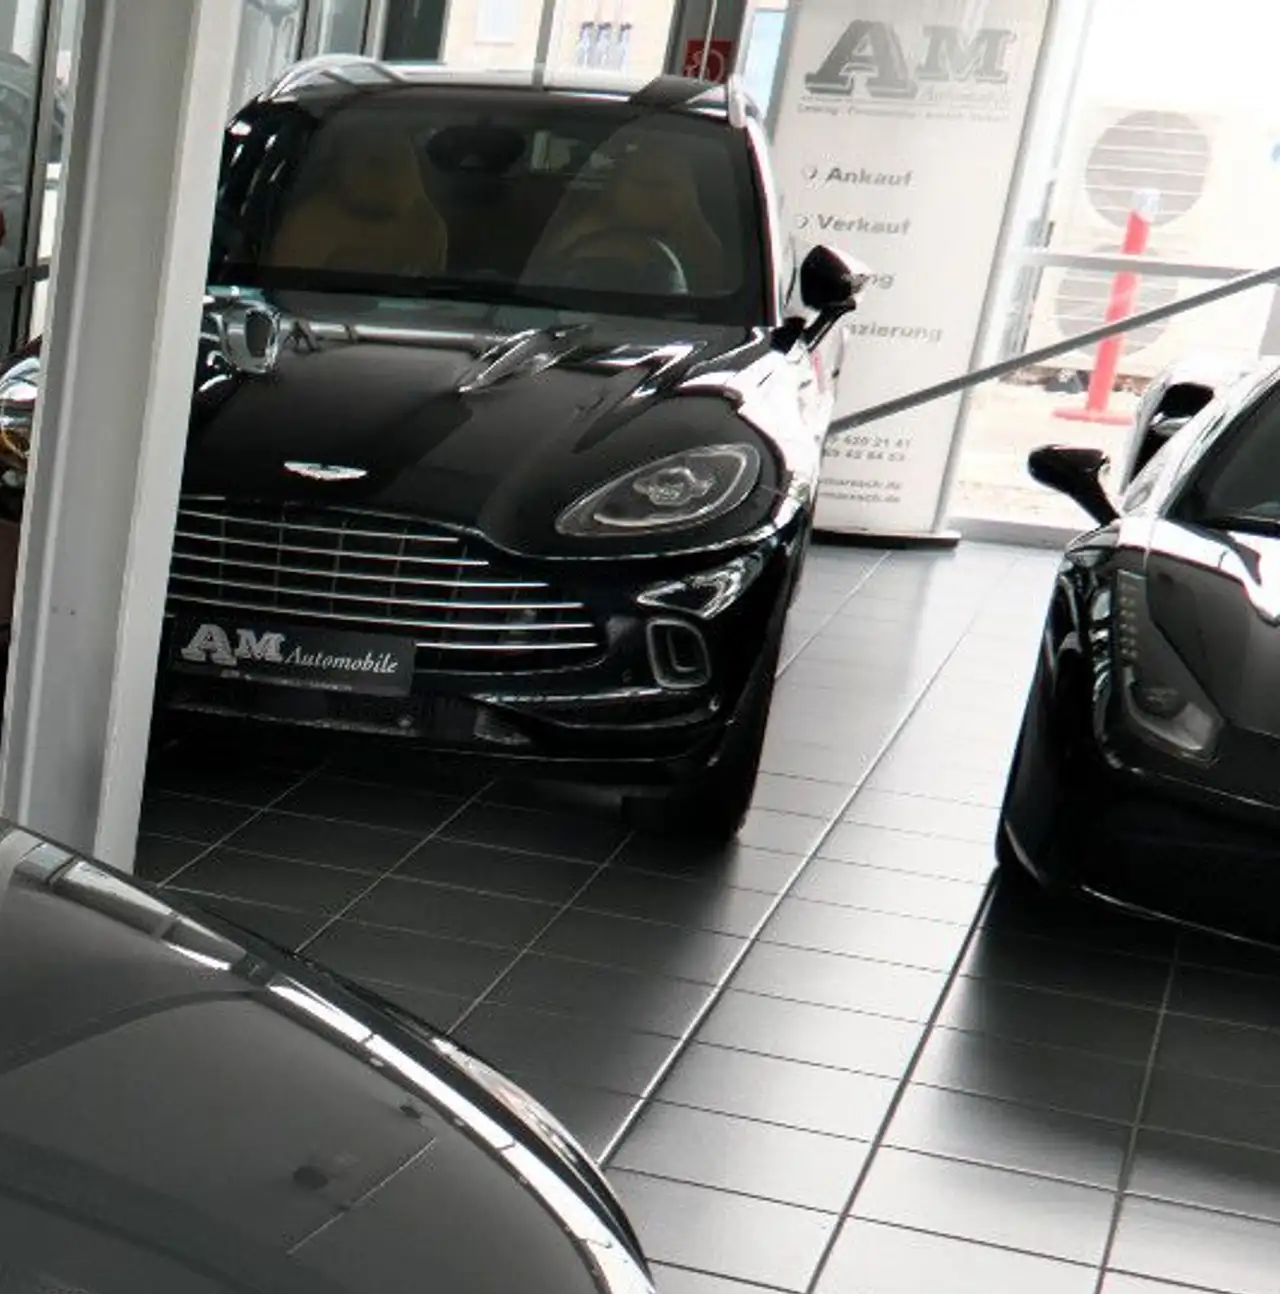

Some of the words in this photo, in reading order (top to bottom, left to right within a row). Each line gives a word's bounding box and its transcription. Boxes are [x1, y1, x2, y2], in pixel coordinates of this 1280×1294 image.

[804, 18, 1017, 98] AM
[825, 167, 914, 186] Ankauf
[816, 212, 911, 235] Verkauf
[181, 623, 286, 667] AM
[285, 646, 399, 674] Automobile
